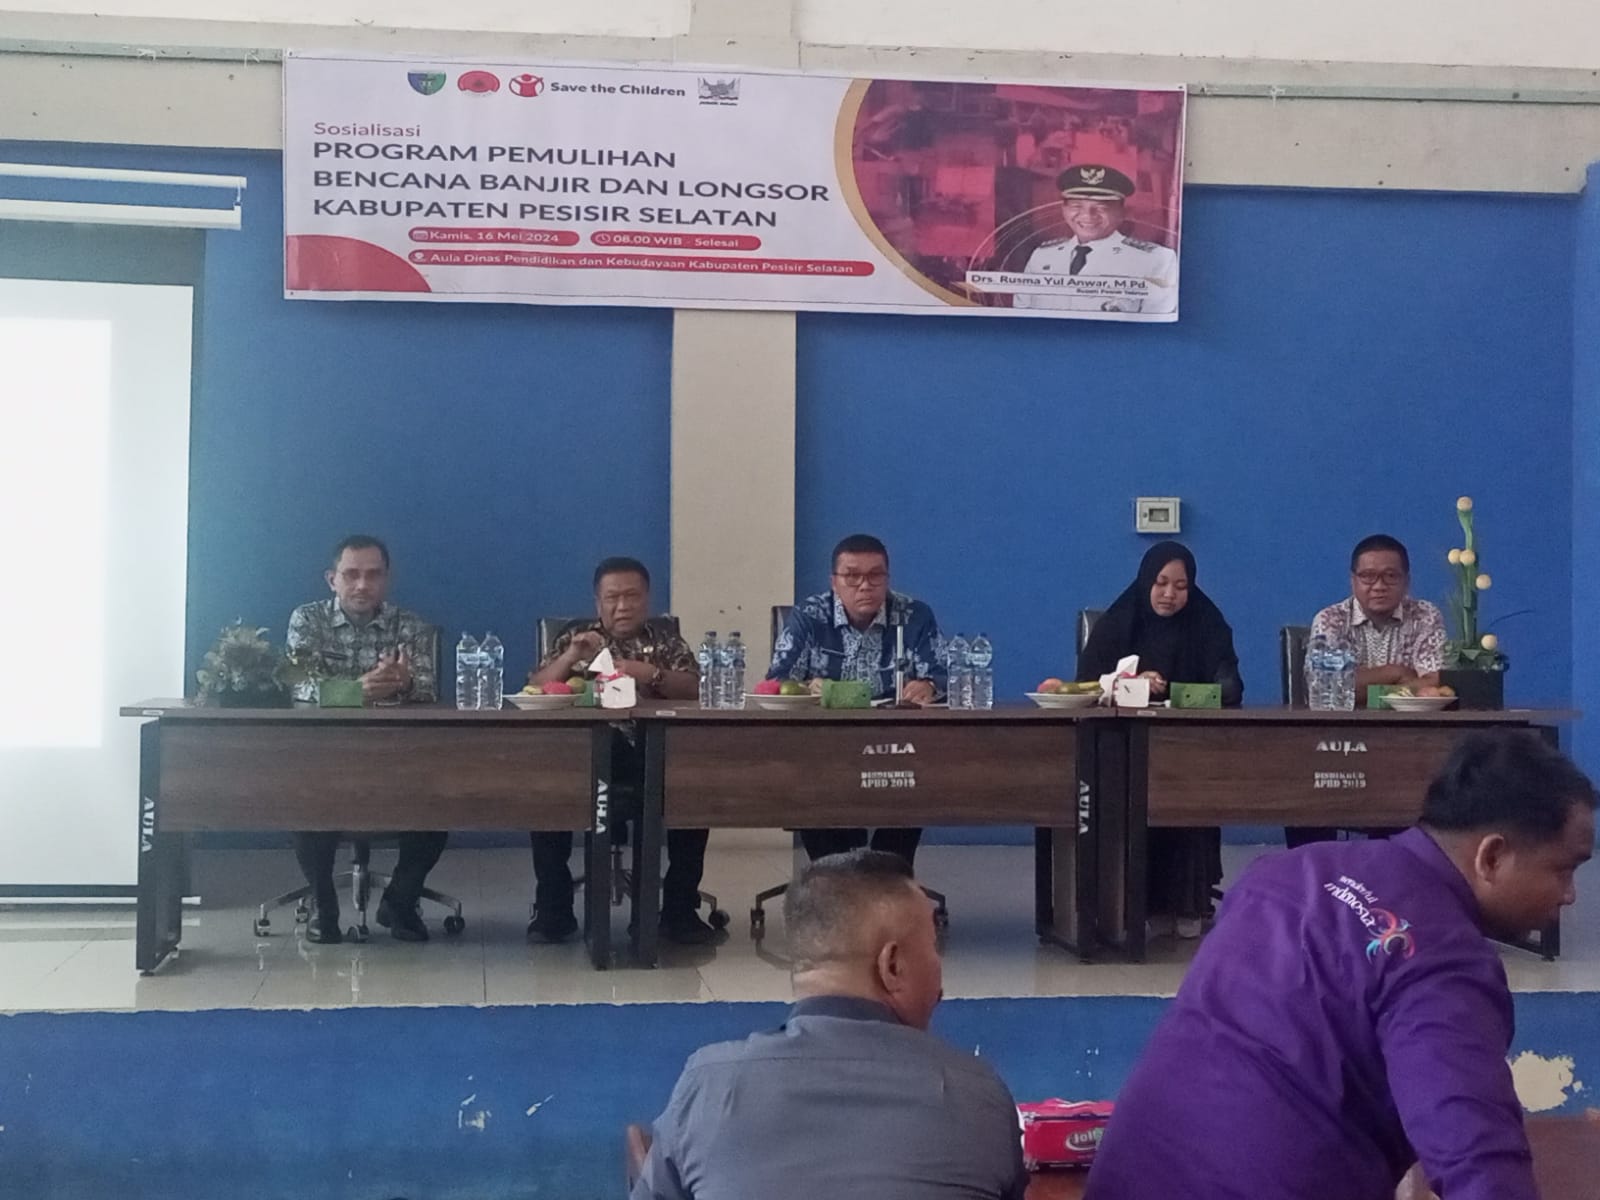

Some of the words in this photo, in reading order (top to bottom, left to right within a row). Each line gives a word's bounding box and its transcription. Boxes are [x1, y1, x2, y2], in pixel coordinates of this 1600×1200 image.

[551, 82, 587, 94] Save
[591, 83, 615, 94] the
[620, 84, 686, 97] Children
[314, 122, 421, 137] Sosialisasi
[314, 142, 477, 162] PROGRAM
[488, 146, 675, 168] PEMULIHAN
[314, 171, 471, 190] BENCANA
[480, 174, 590, 193] BANJIR
[600, 178, 668, 195] DAN
[679, 181, 829, 201] LONGSOR
[314, 199, 508, 219] KABUPATEN
[519, 203, 630, 222] PESISIR
[639, 207, 777, 227] SELATAN
[478, 232, 493, 240] 16
[498, 232, 523, 241] Mei
[526, 233, 559, 242] 2024
[613, 234, 651, 244] 08.00
[653, 236, 682, 245] WIB
[694, 238, 739, 248] Selesai
[430, 253, 460, 263] Aula
[464, 254, 501, 263] Dinas
[504, 254, 576, 265] Pendidikan
[579, 256, 603, 265] dan
[606, 257, 685, 269] Kebudayaan
[689, 260, 759, 272] Kabupaten
[762, 262, 802, 272] Pesisir
[806, 262, 854, 273] Selatan
[1000, 275, 1041, 285] Rusma
[1043, 277, 1064, 286] Yul
[862, 742, 916, 755] AULA
[1316, 741, 1368, 756] AULA
[596, 779, 608, 834] AULA
[1079, 780, 1089, 834] AULA
[142, 796, 154, 852] AULA
